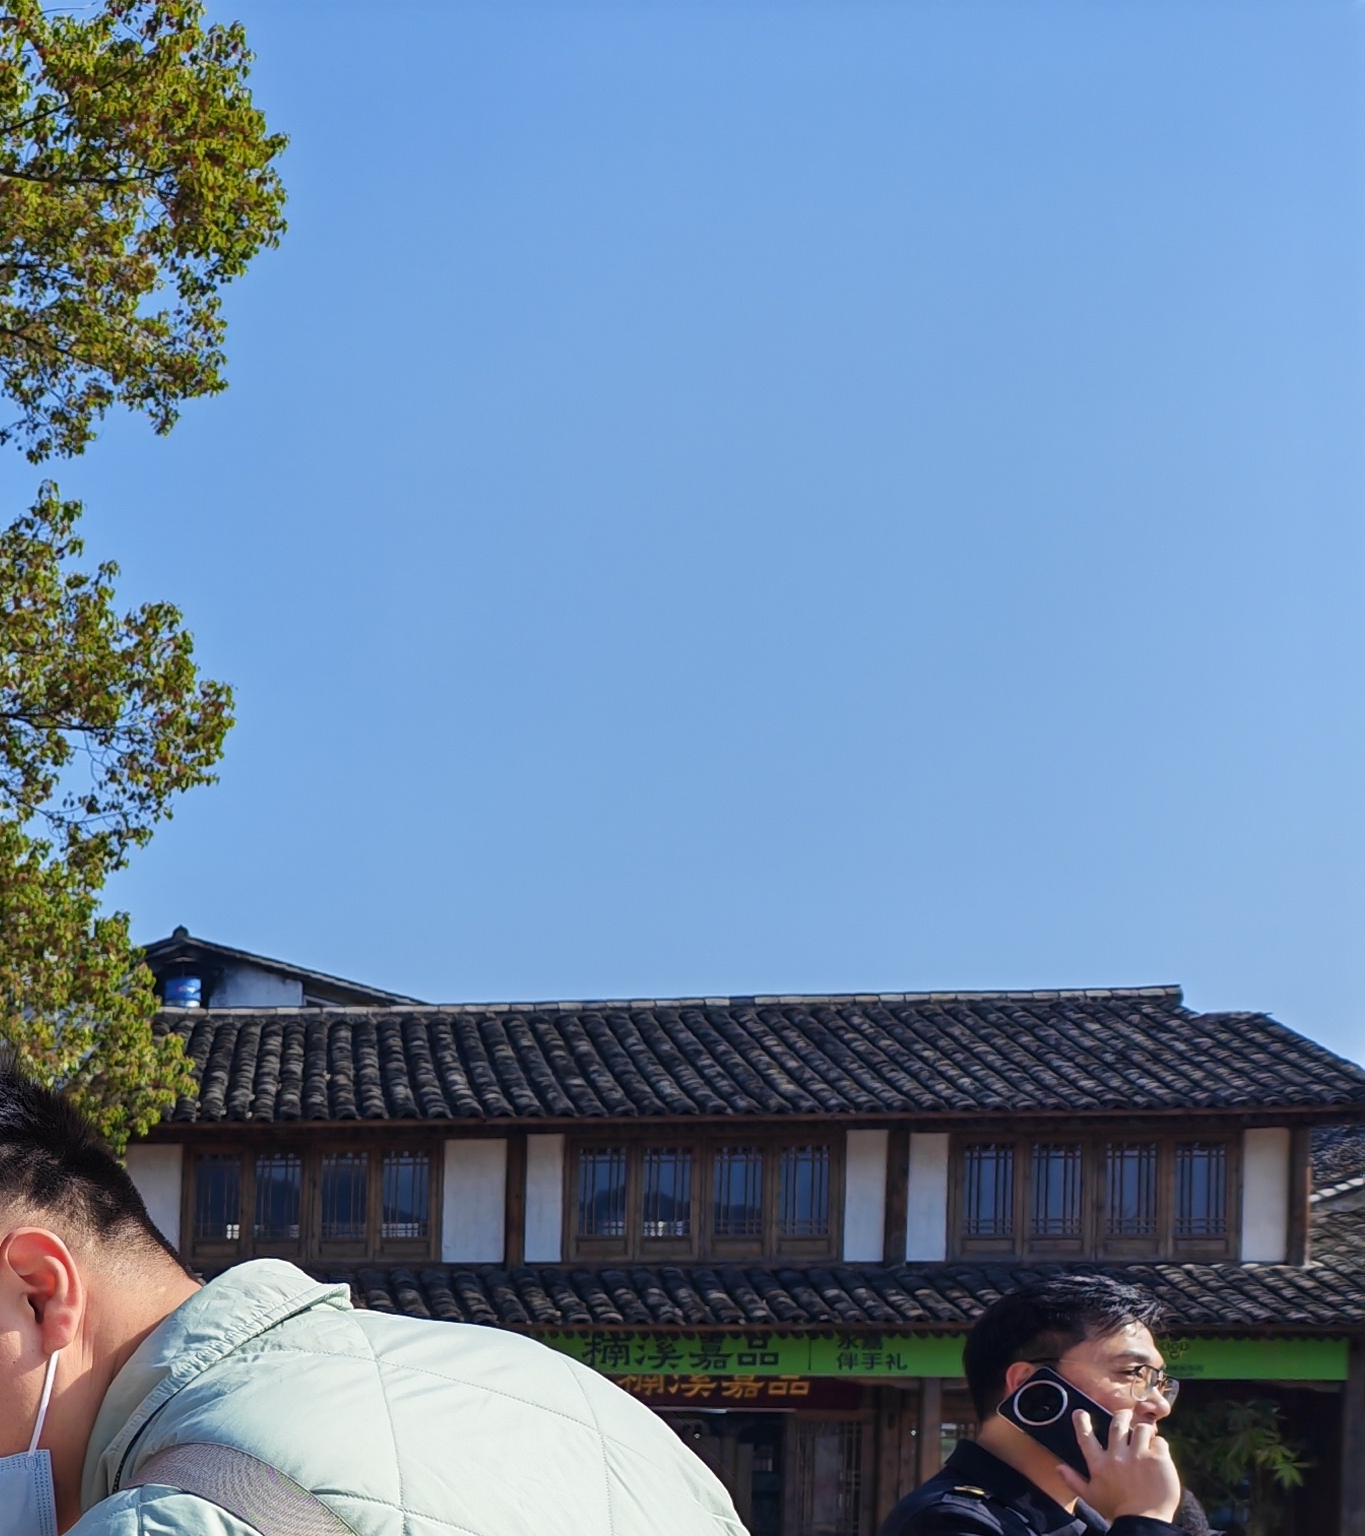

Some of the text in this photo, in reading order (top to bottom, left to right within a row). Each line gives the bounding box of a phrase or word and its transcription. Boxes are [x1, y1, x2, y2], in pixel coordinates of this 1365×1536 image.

[581, 1332, 780, 1371] 楠溪嘉品
[837, 1352, 909, 1371] 伴手礼
